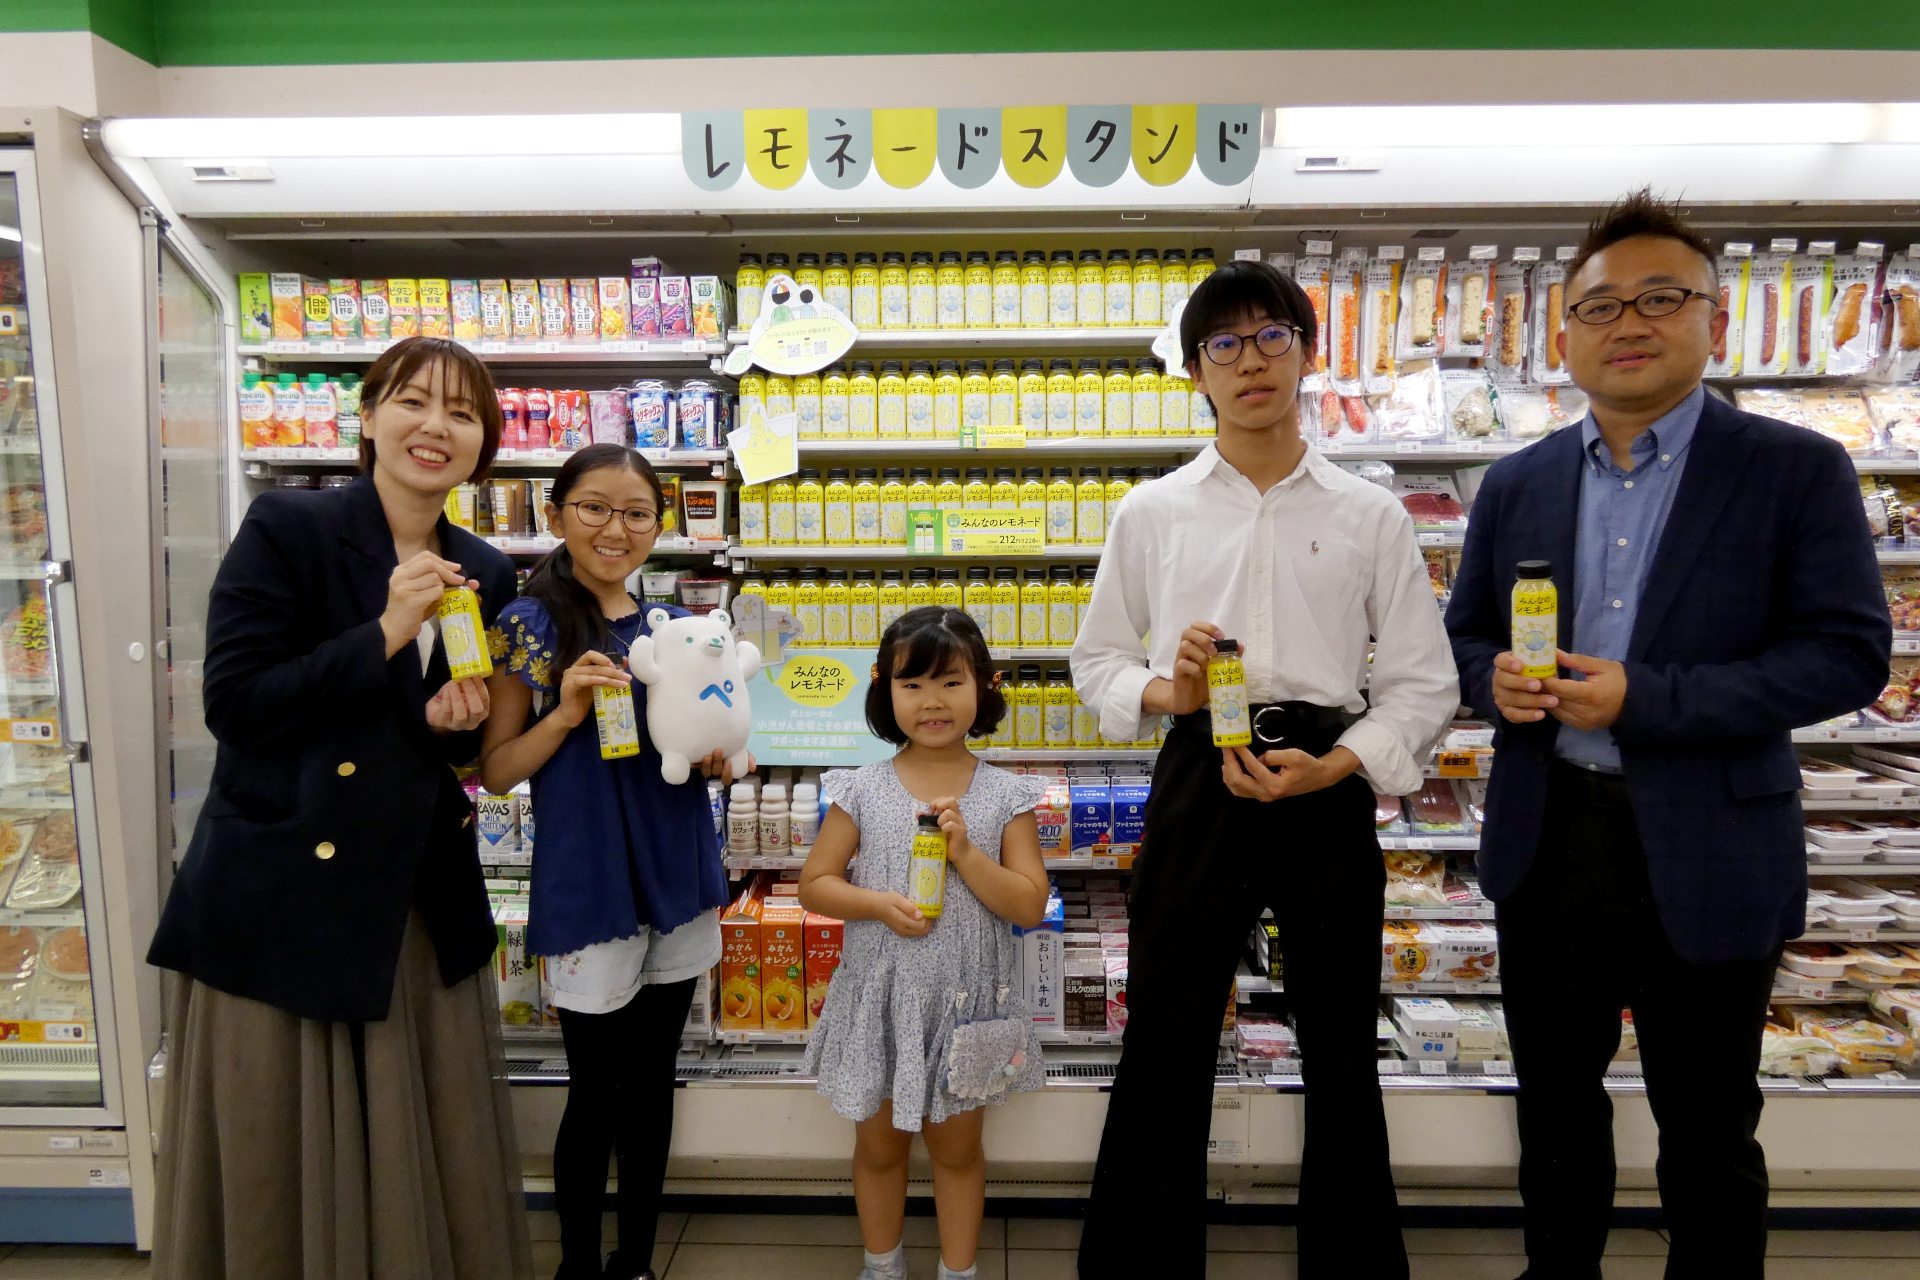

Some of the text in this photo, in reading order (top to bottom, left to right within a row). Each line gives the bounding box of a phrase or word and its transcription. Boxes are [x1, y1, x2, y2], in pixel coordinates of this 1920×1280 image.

[705, 118, 1249, 179] レモネードスタンド
[272, 274, 298, 284] Tropicana
[389, 288, 414, 296] ビタミン
[420, 288, 445, 296] ビタミン
[528, 401, 548, 411] Y1000
[961, 517, 1041, 528] みんなのレモネード
[1520, 596, 1550, 605] みんなの
[440, 602, 468, 616] モネード
[1516, 602, 1555, 614] レモネード
[794, 666, 841, 678] みんなの
[1213, 667, 1240, 676] みんなの
[791, 678, 846, 691] レモネード
[1212, 674, 1243, 685] レモネード
[771, 736, 857, 746] サポートをする活動へ
[485, 814, 500, 822] MILK
[1039, 825, 1062, 837] 400
[914, 849, 944, 858] レモネード
[507, 931, 522, 976] 緑茶
[723, 955, 757, 963] オレンジ
[764, 956, 798, 964] オレンジ
[1038, 942, 1050, 1008] おいしい牛乳
